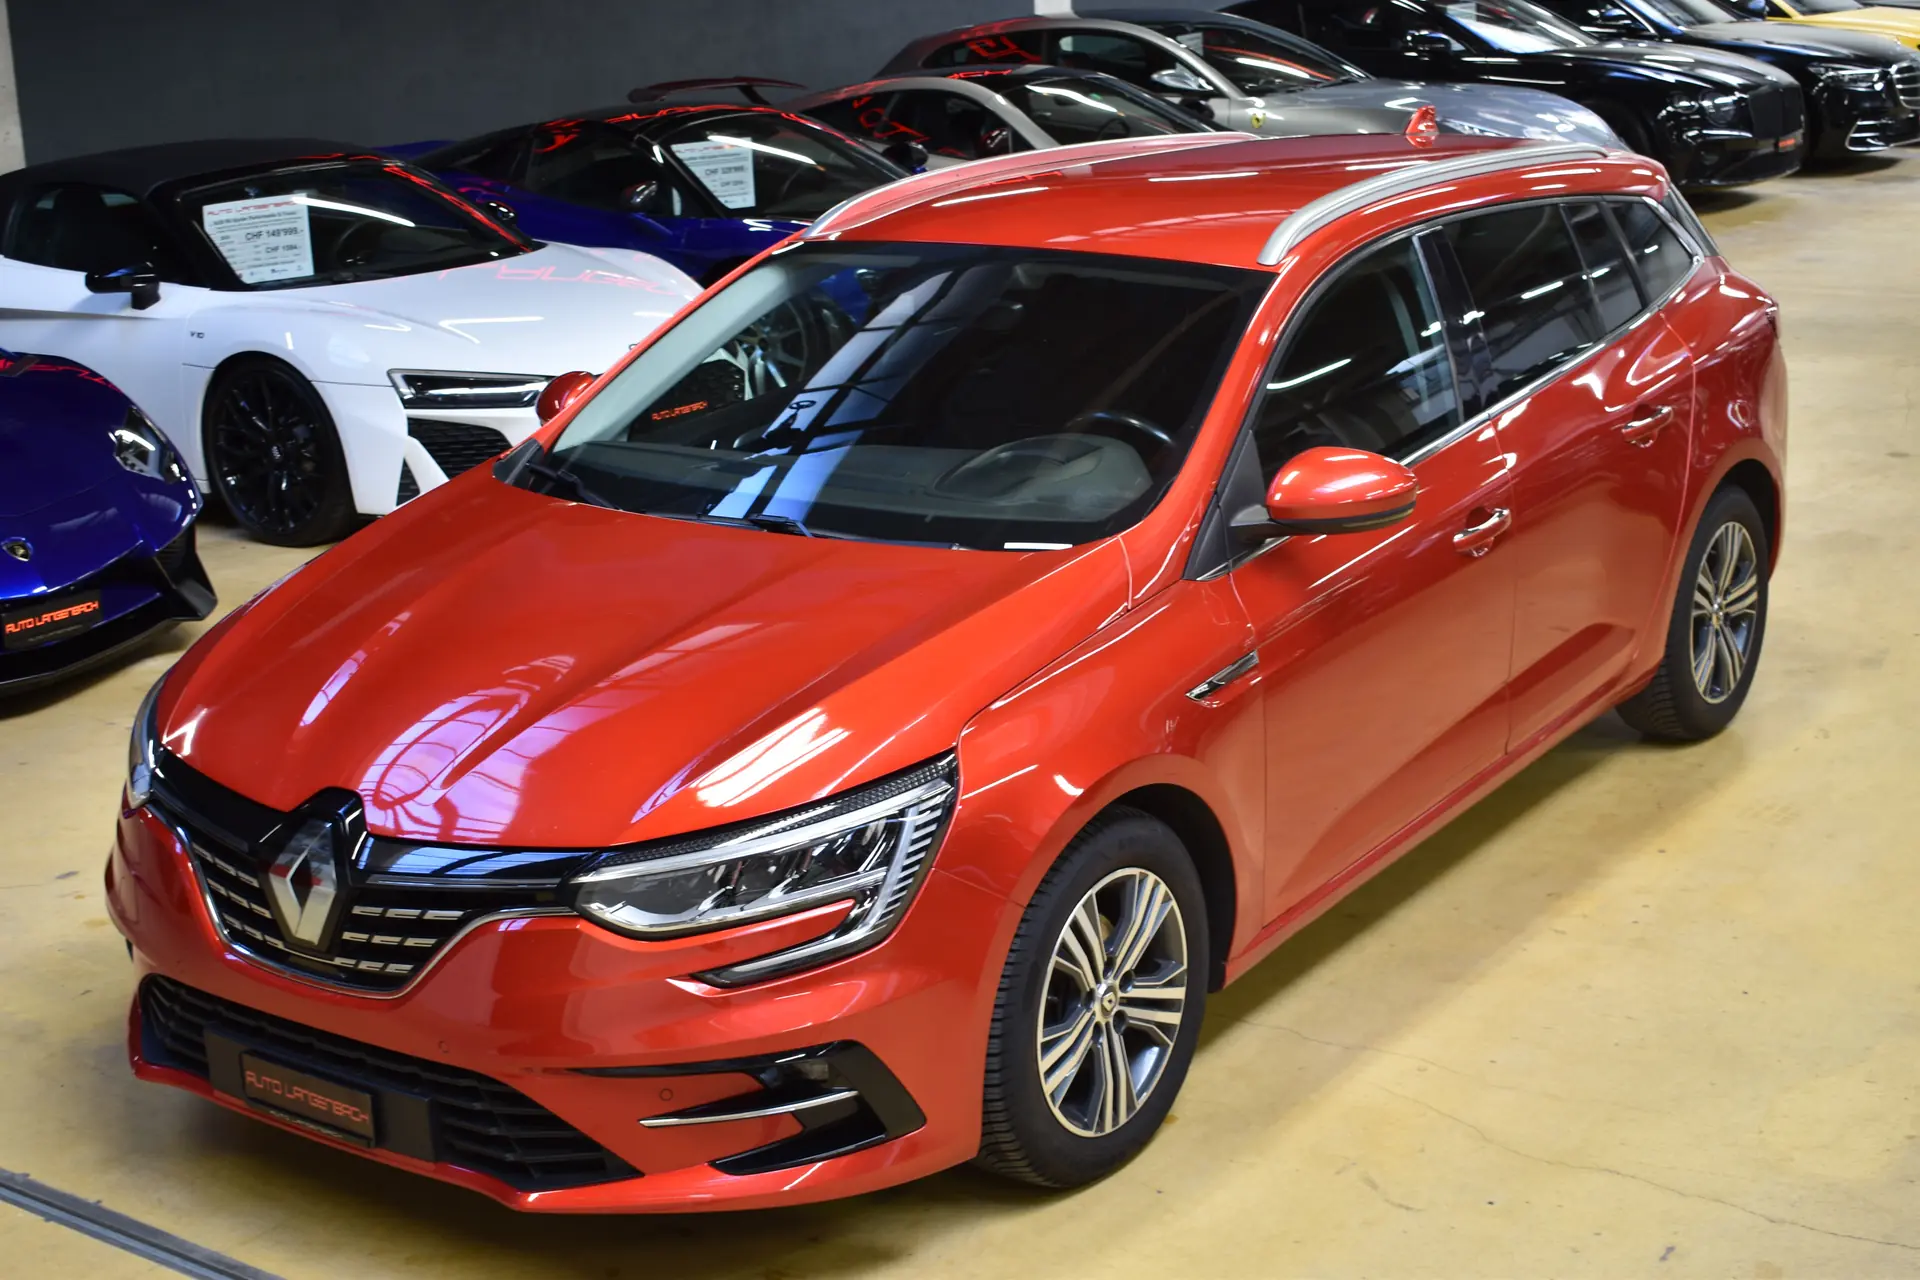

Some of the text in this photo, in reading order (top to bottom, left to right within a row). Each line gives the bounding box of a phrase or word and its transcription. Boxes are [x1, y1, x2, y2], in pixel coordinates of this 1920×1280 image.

[245, 230, 263, 241] CHF
[5, 617, 34, 634] AUTO
[36, 601, 99, 626] LANGENBACH
[245, 1070, 369, 1123] AUTO LANGENBACH
